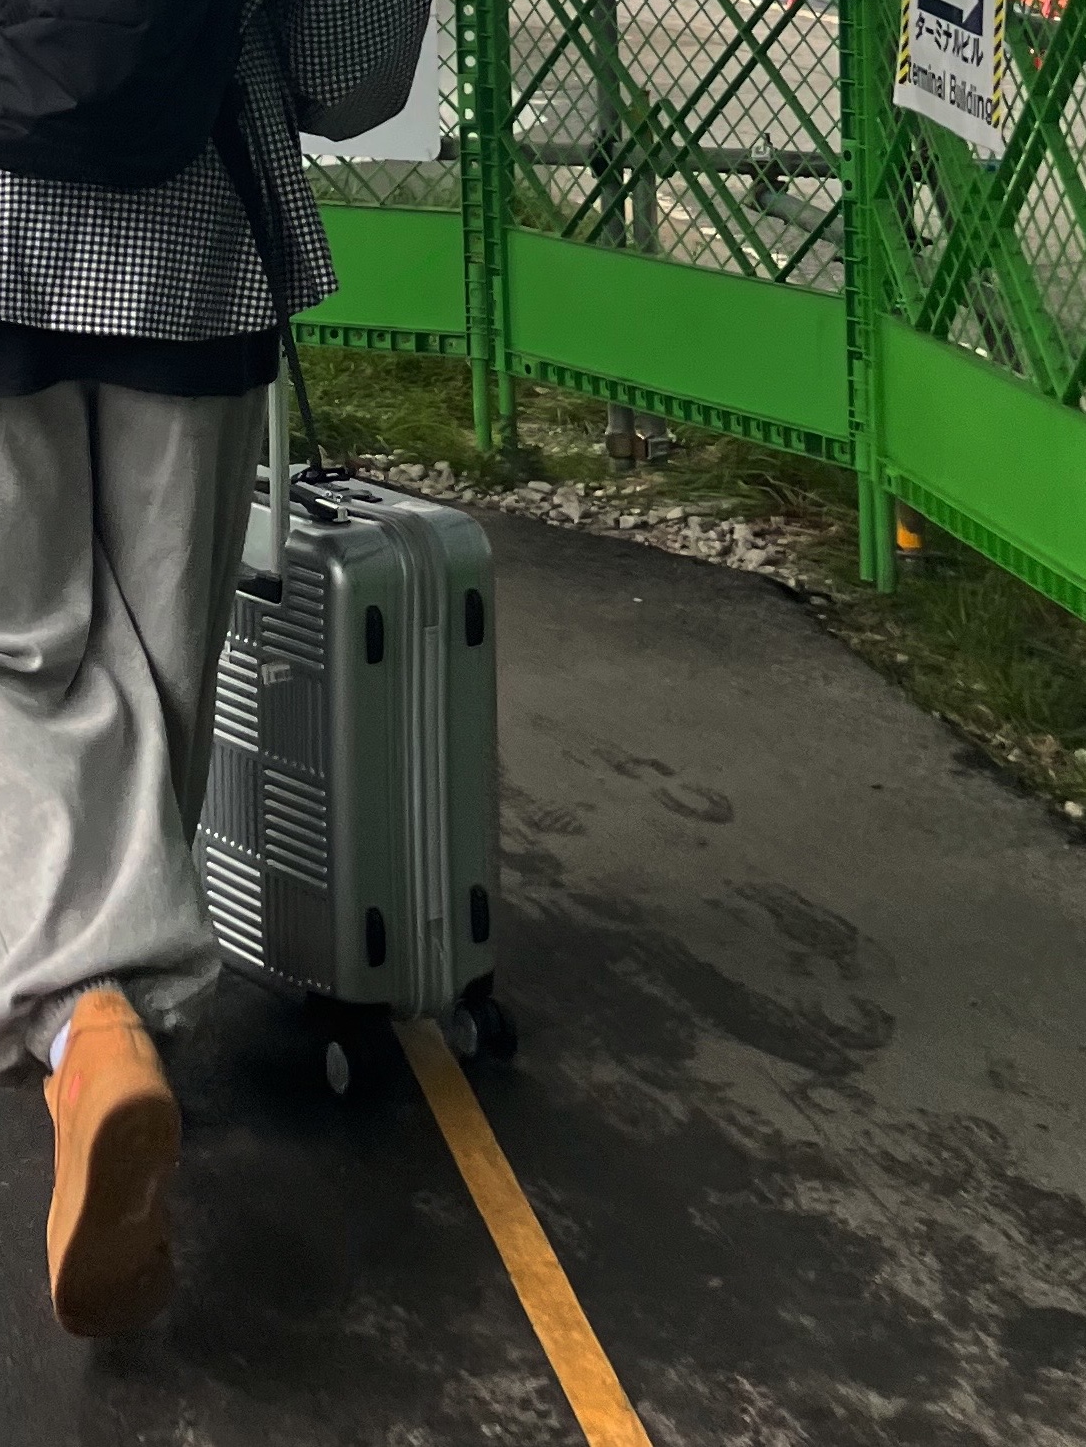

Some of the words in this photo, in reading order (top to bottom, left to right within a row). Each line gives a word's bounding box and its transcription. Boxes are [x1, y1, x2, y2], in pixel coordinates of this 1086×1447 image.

[916, 12, 984, 67] ターミナルビル
[950, 73, 993, 125] Building
